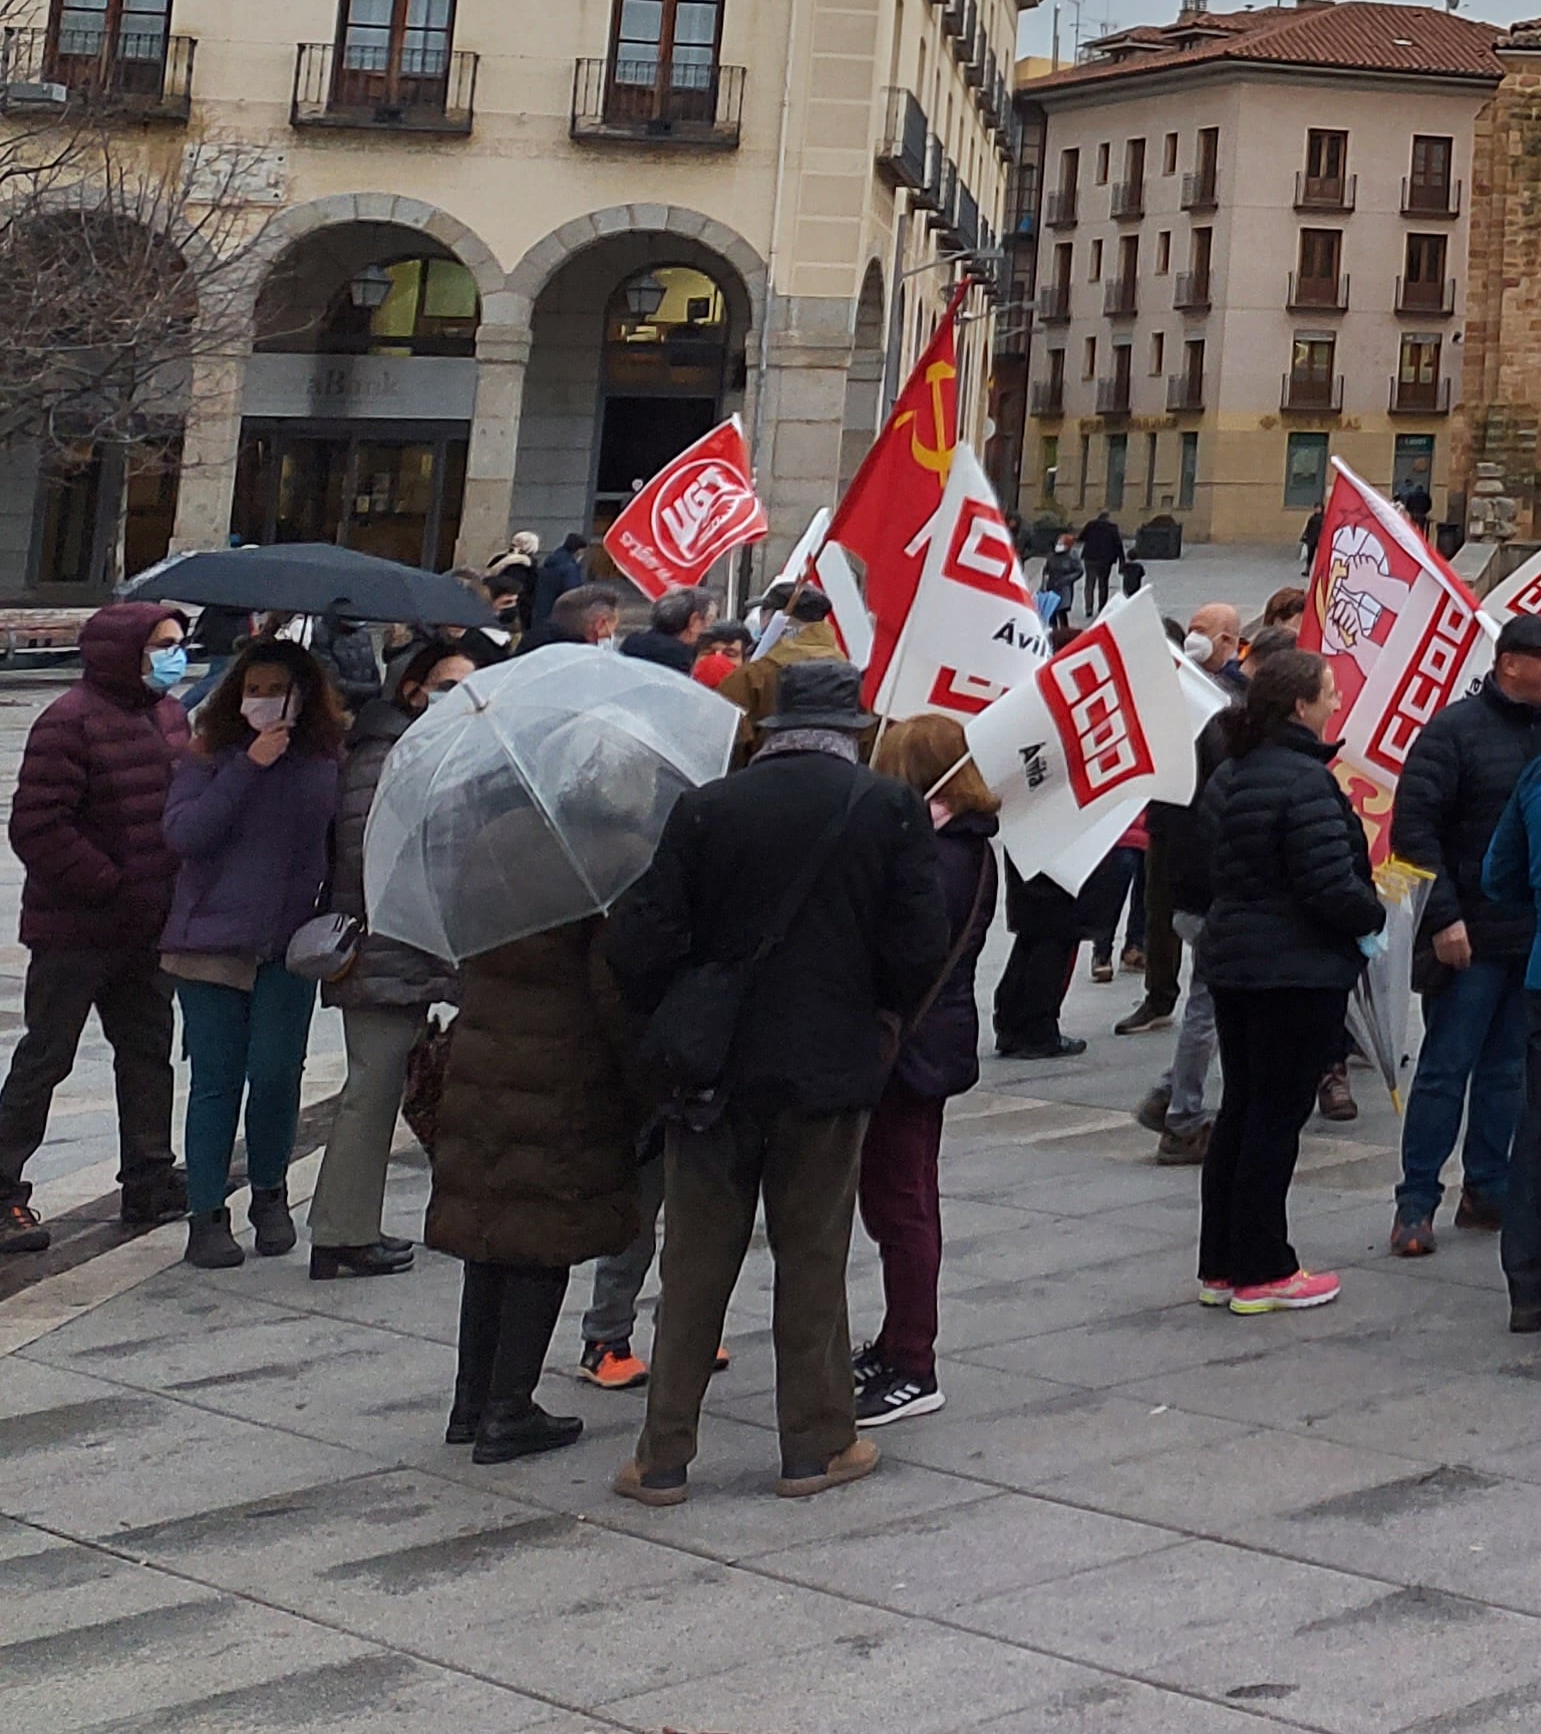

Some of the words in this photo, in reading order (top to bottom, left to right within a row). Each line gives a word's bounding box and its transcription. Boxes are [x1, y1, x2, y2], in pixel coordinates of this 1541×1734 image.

[661, 465, 736, 556] UGT
[1050, 641, 1138, 790] CCOO
[1377, 601, 1474, 765] CCOO
